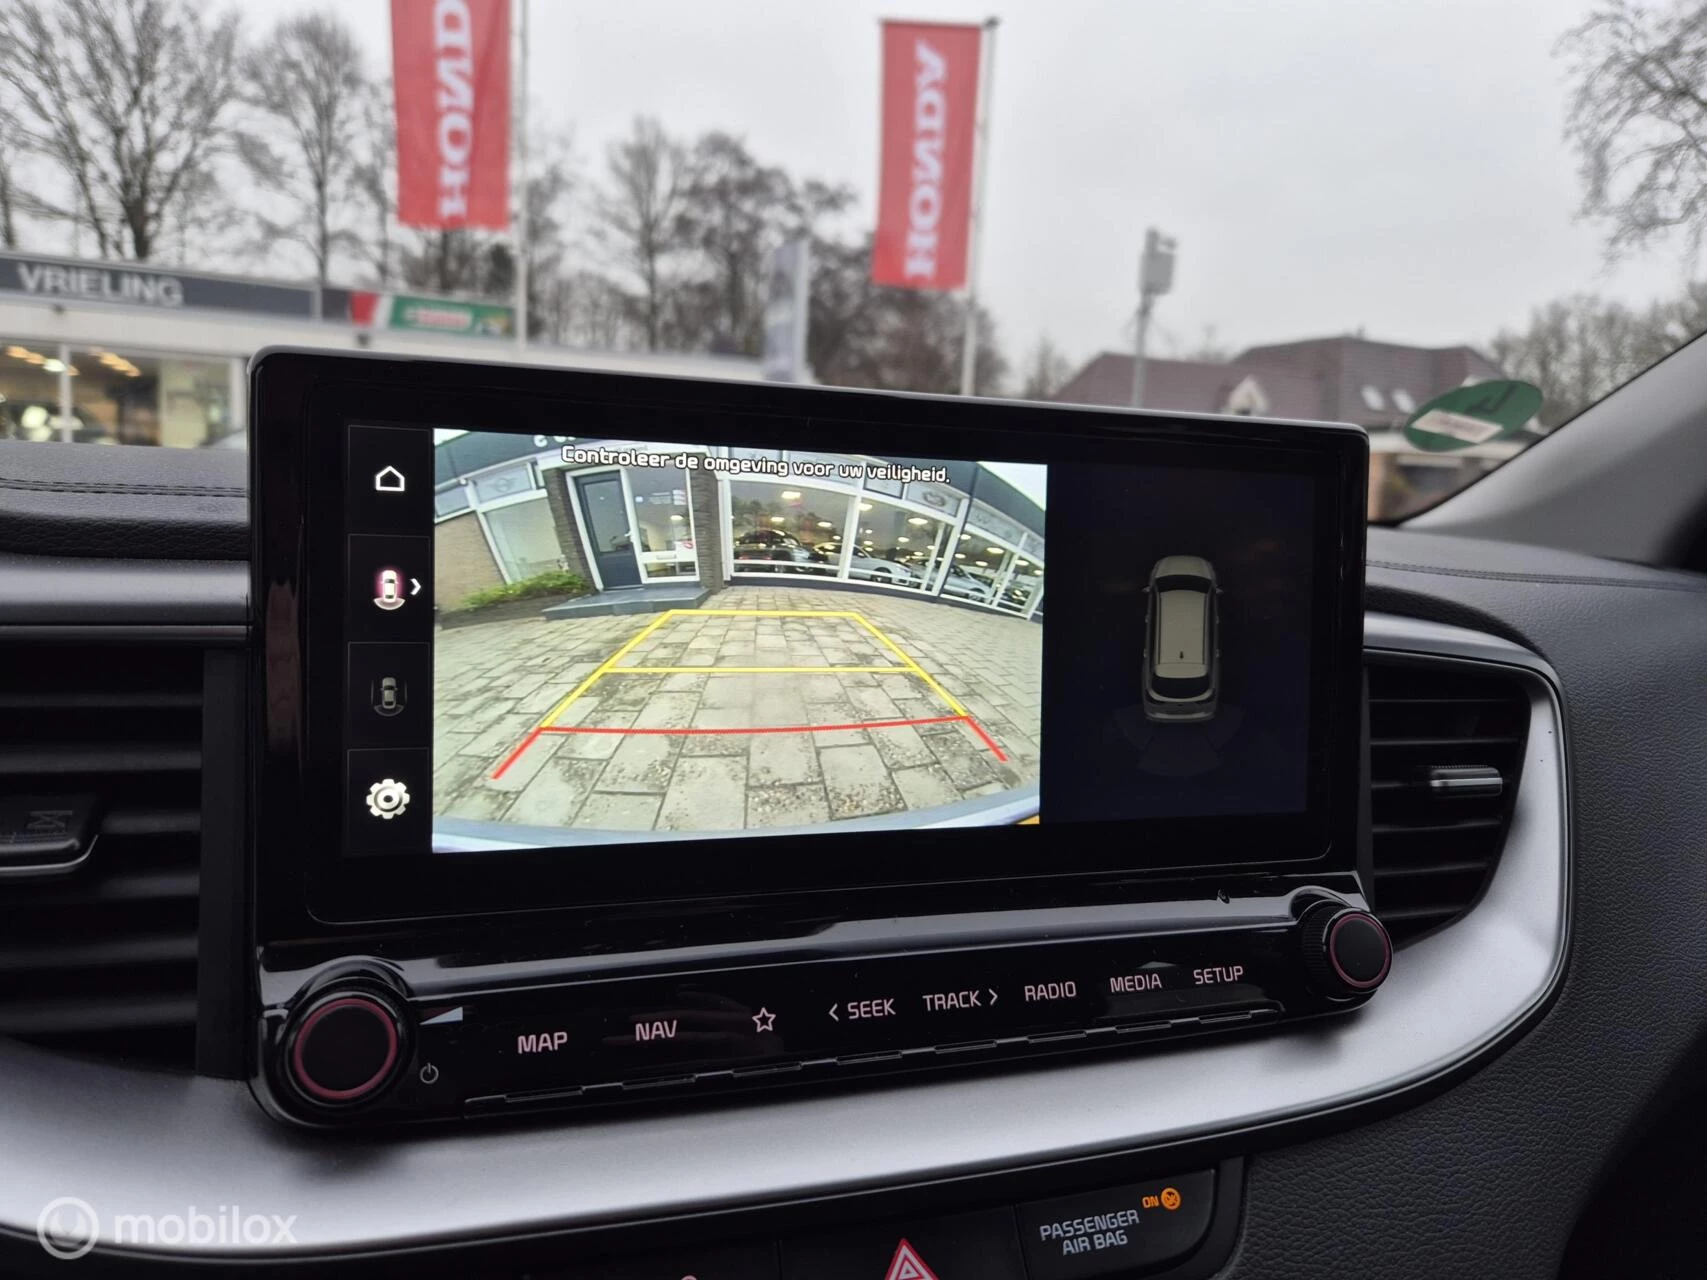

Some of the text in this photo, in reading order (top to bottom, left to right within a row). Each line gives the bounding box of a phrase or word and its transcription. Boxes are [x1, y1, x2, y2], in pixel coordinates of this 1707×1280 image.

[16, 262, 184, 307] VRIELING
[561, 445, 671, 467] Controleer
[675, 452, 699, 469] de
[703, 457, 789, 477] omgeving
[793, 463, 834, 476] voor
[839, 465, 863, 478] uw
[867, 464, 951, 484] veiligheid.
[1109, 973, 1162, 993] MEDIA
[1193, 965, 1244, 985] SETUP
[922, 989, 982, 1012] TRACK
[1024, 981, 1077, 1002] RADIO
[847, 998, 896, 1020] SEEK
[635, 1020, 678, 1041] NAV
[517, 1031, 569, 1055] MAP
[1141, 1196, 1160, 1209] ON
[1039, 1209, 1140, 1241] PASSENGER
[1062, 1230, 1129, 1256] AIR BAG
